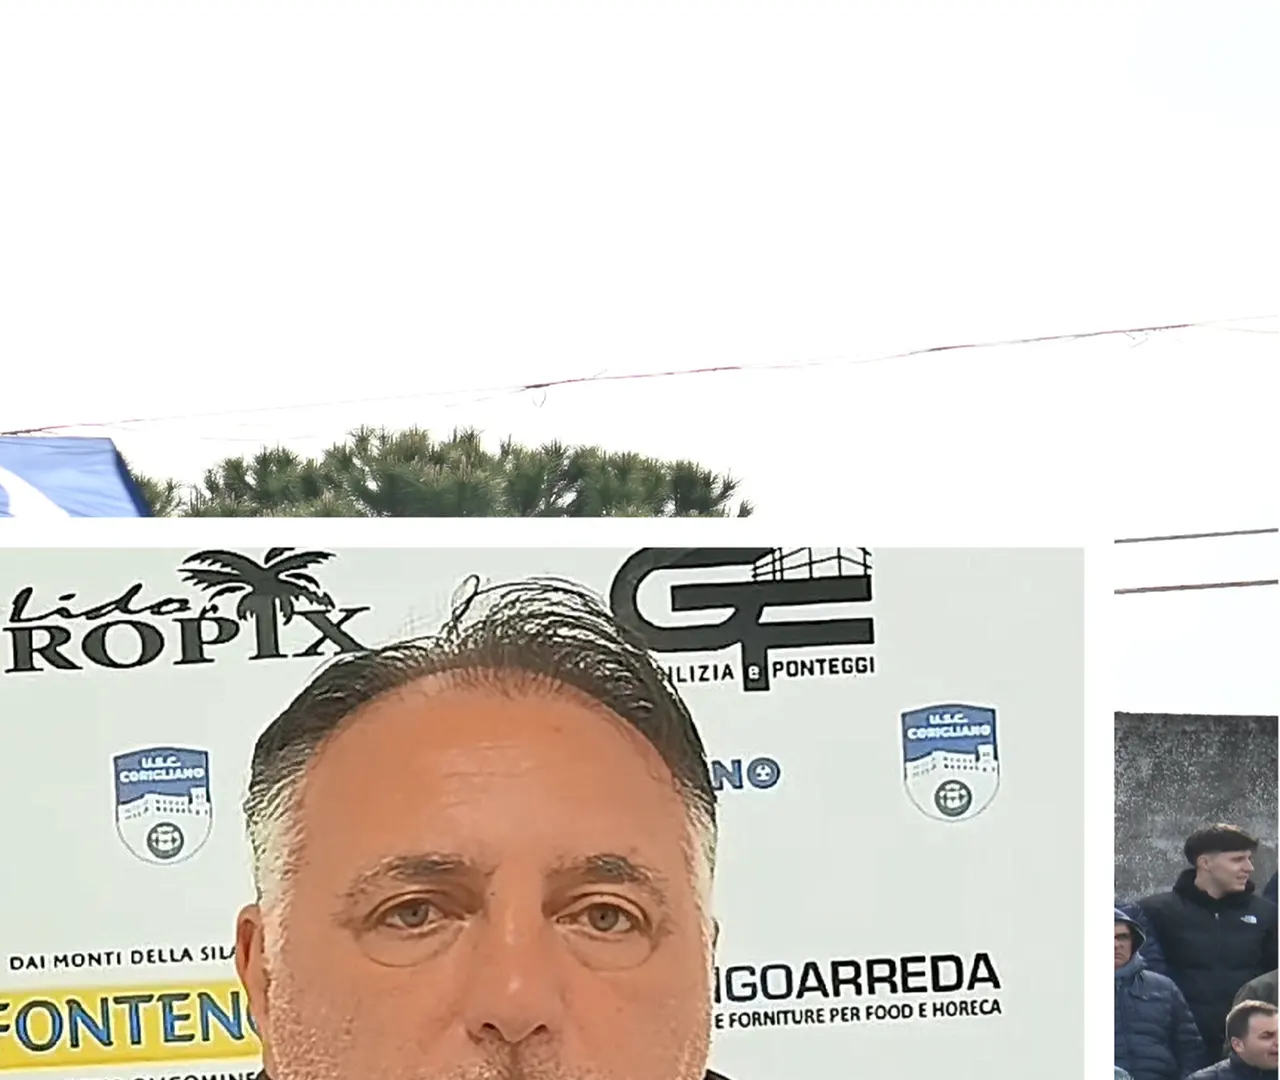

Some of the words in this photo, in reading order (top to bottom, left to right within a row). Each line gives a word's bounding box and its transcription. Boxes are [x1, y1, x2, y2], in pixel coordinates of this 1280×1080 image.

[748, 664, 761, 681] e
[772, 657, 875, 678] PONTEGGI
[907, 725, 991, 739] CORIGLIANO
[119, 767, 205, 783] CORIGLIANO
[9, 955, 45, 971] DAI
[53, 951, 122, 968] MONTI
[130, 947, 193, 965] DELLA
[714, 1016, 725, 1029] E
[729, 1009, 826, 1028] FORNITURE
[829, 1006, 861, 1023] PER
[865, 1003, 914, 1020] FOOD
[918, 1002, 928, 1018] E
[932, 999, 1003, 1017] HORECA
